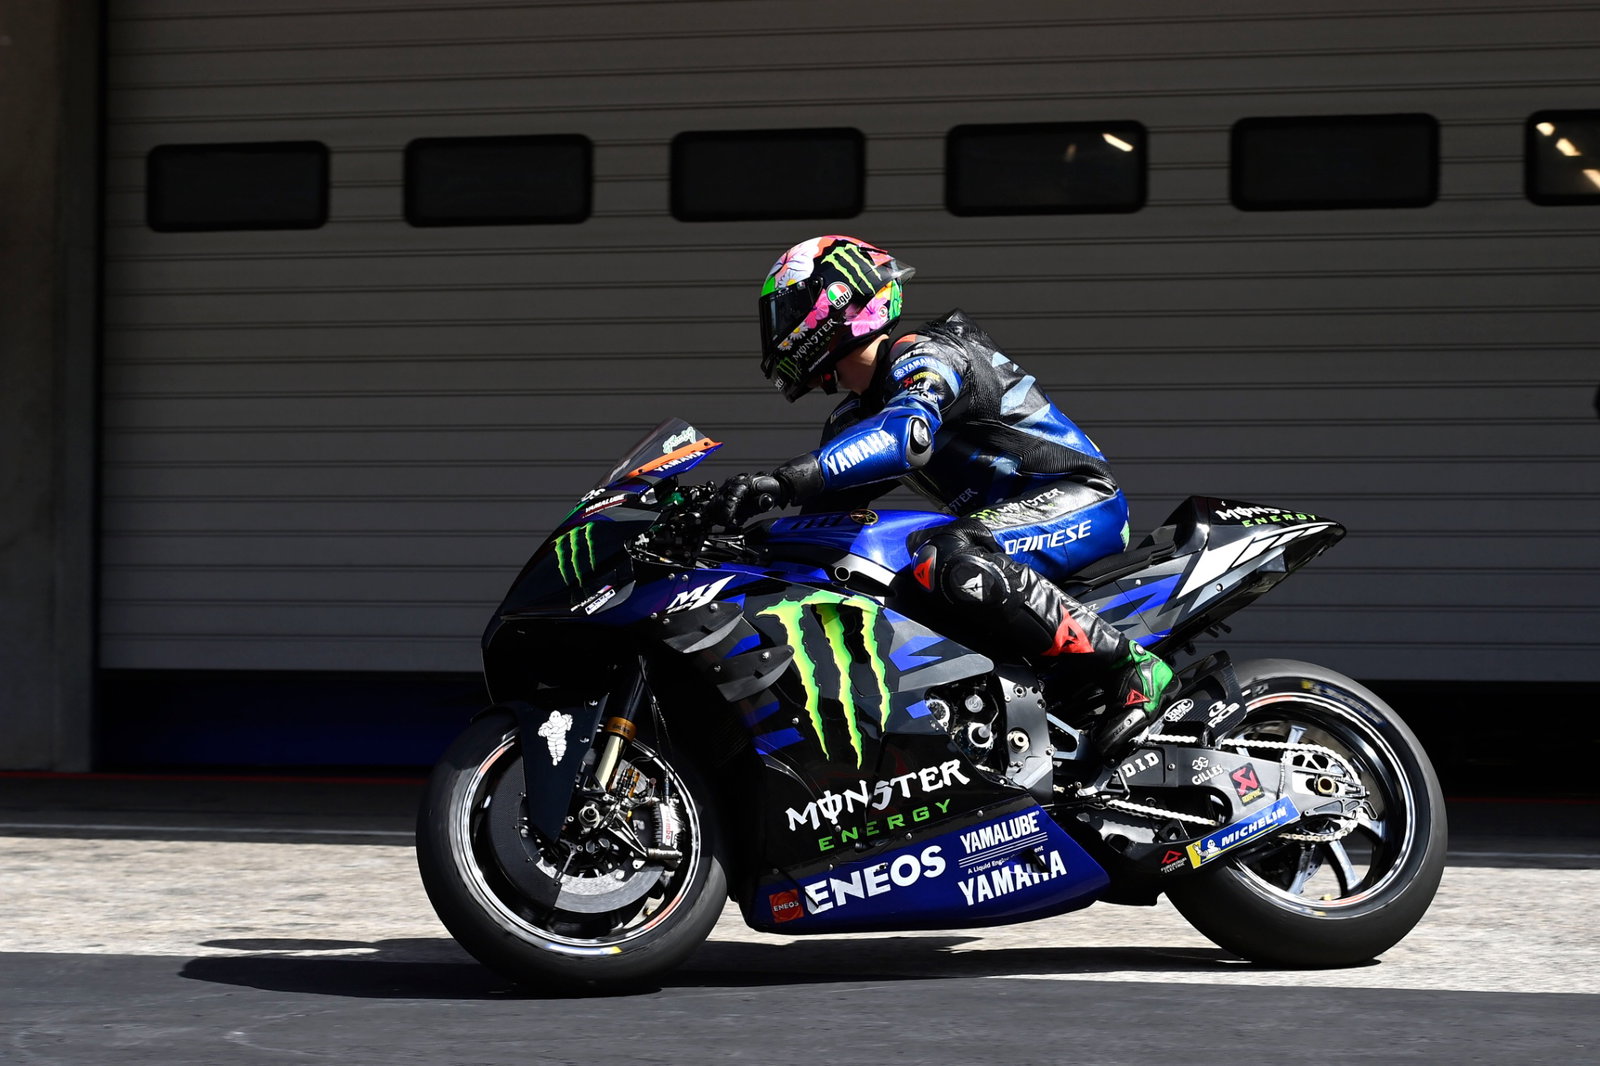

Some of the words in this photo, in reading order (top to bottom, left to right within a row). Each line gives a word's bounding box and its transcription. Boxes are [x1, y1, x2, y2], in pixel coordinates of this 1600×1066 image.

[792, 317, 839, 362] MONSTER
[653, 451, 707, 472] YAMAHA
[823, 429, 898, 476] YAMAHA
[1003, 519, 1093, 556] DAINESE
[1241, 512, 1318, 528] ENERGY
[784, 757, 971, 832] MONSTER
[1191, 764, 1224, 786] GILLES
[817, 798, 951, 853] ENERGY
[1221, 806, 1287, 847] MICHELIN
[804, 845, 947, 915] ENEOS
[957, 849, 1068, 906] YAMAHA
[973, 861, 991, 873] Liquid
[773, 901, 799, 912] ENEOS
